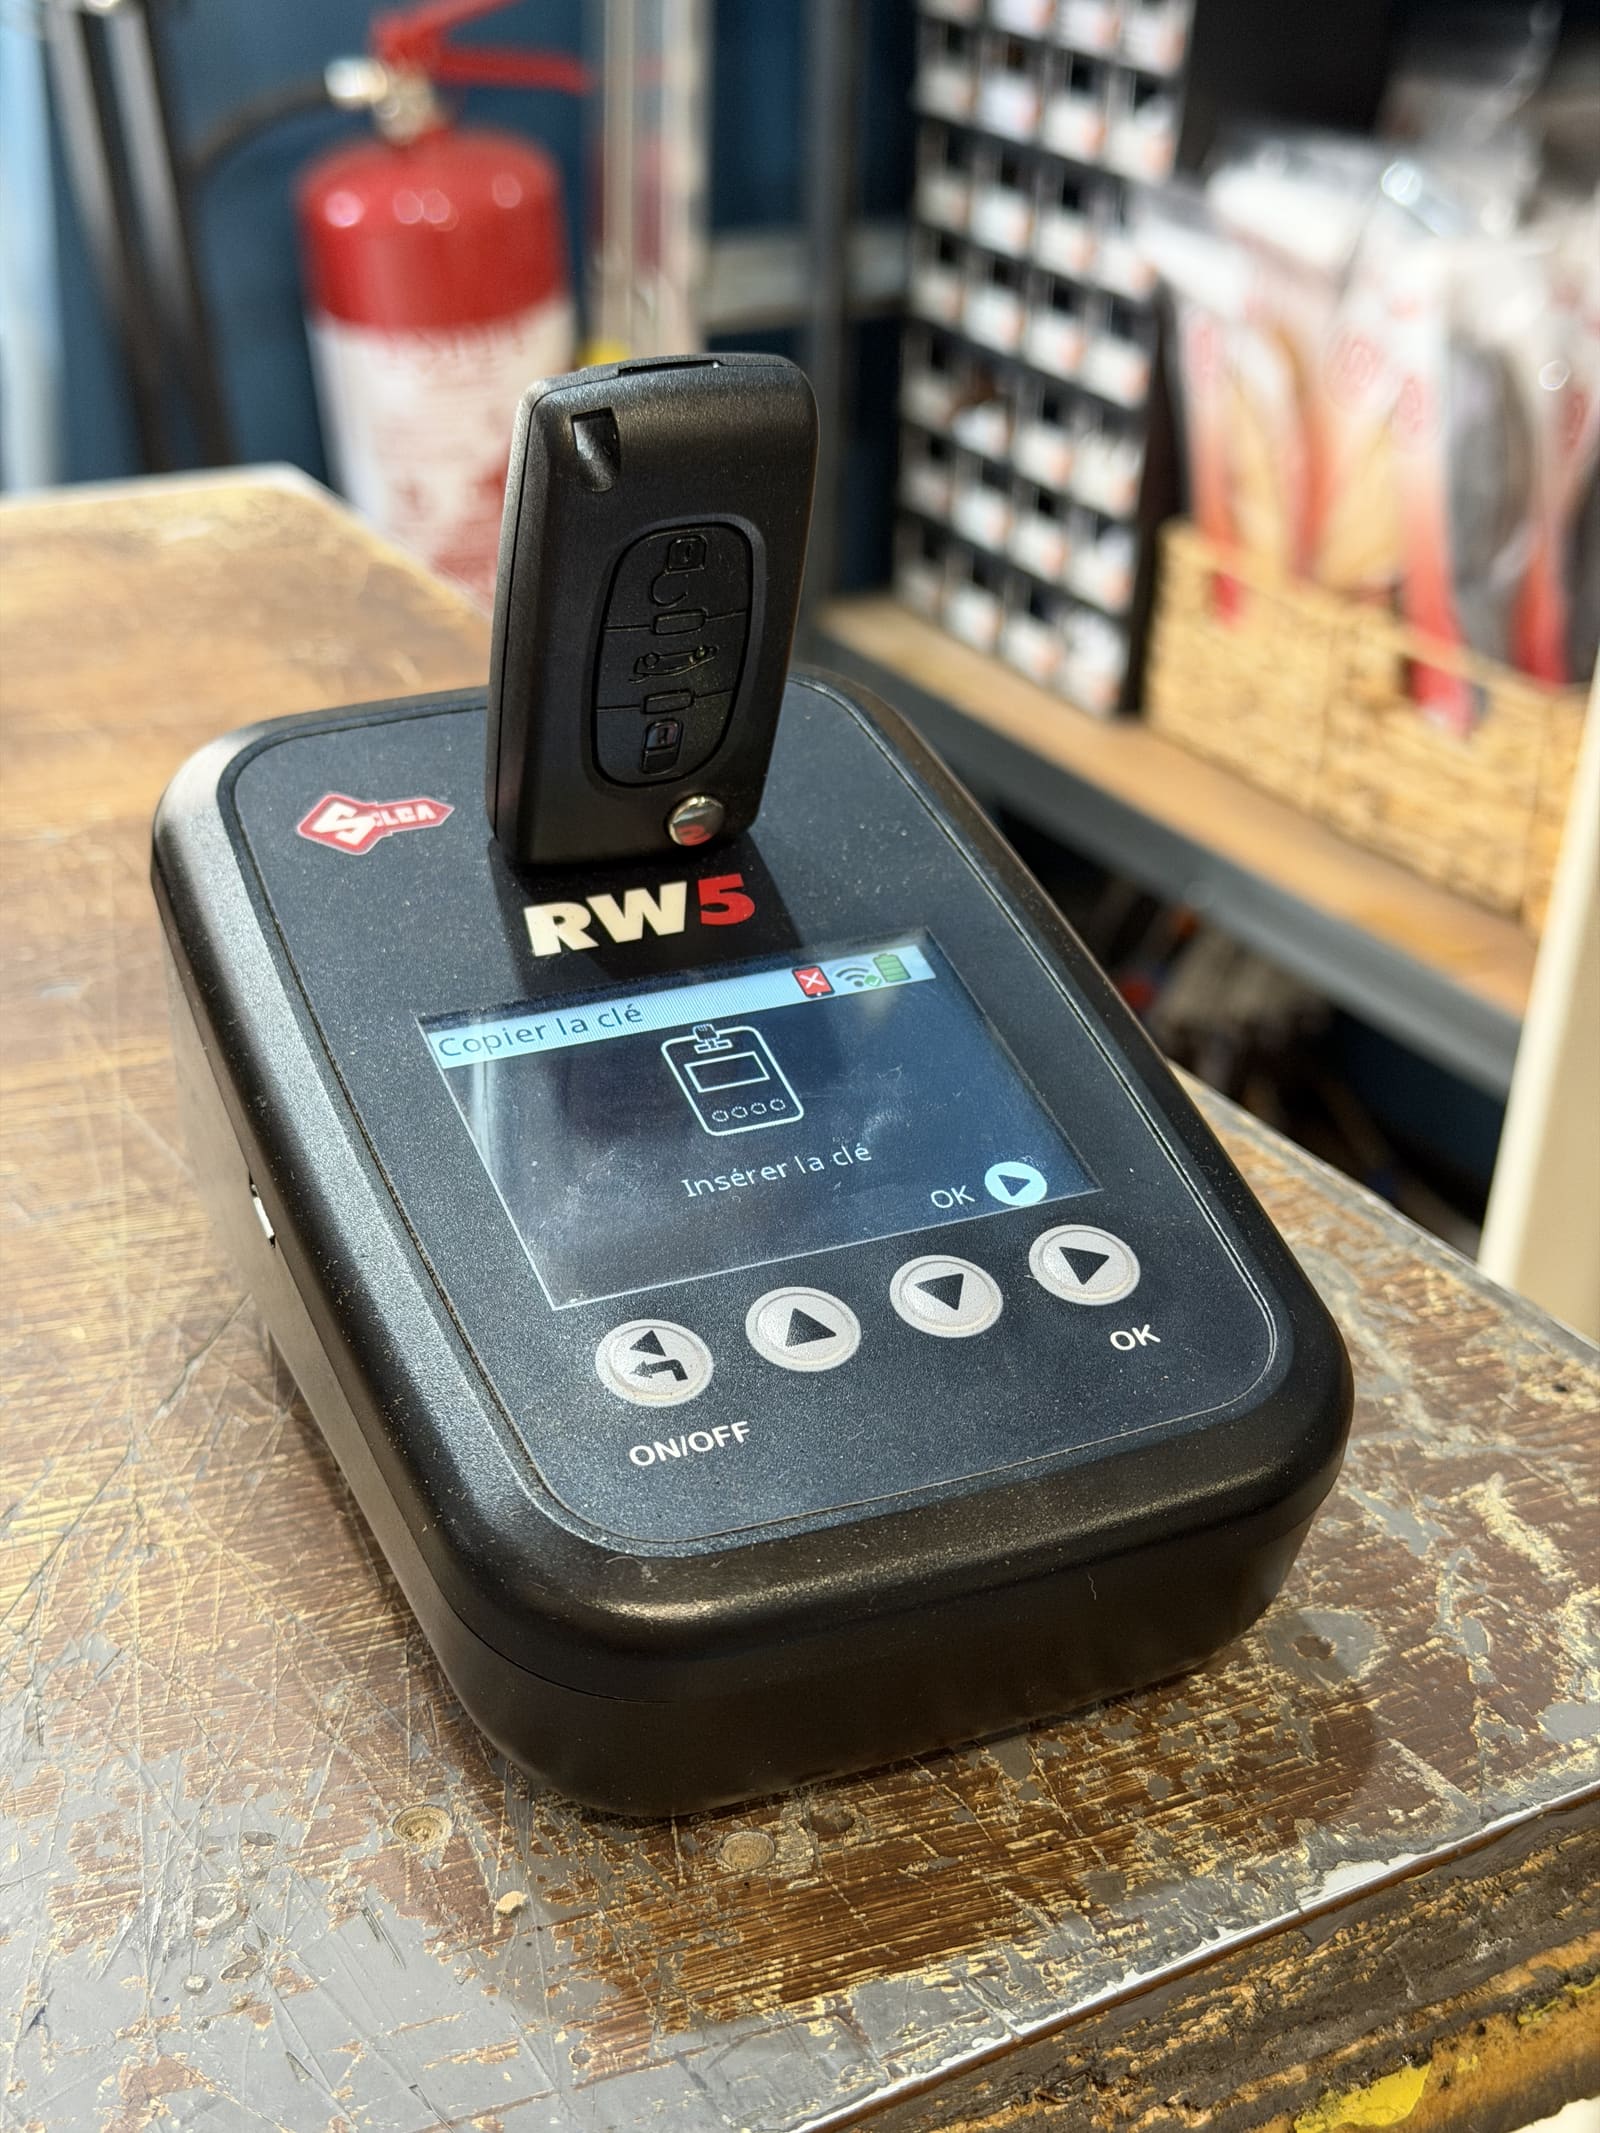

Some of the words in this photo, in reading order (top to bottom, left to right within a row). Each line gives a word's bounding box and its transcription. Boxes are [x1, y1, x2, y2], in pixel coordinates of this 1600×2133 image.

[438, 1023, 547, 1057] Copier
[556, 1017, 589, 1036] la
[598, 1004, 644, 1029] clé
[681, 1162, 788, 1198] Insérer
[795, 1155, 825, 1175] la
[832, 1143, 872, 1167] clé
[930, 1185, 976, 1210] OK
[1109, 1323, 1161, 1352] OK
[628, 1420, 751, 1468] ON/OFF
